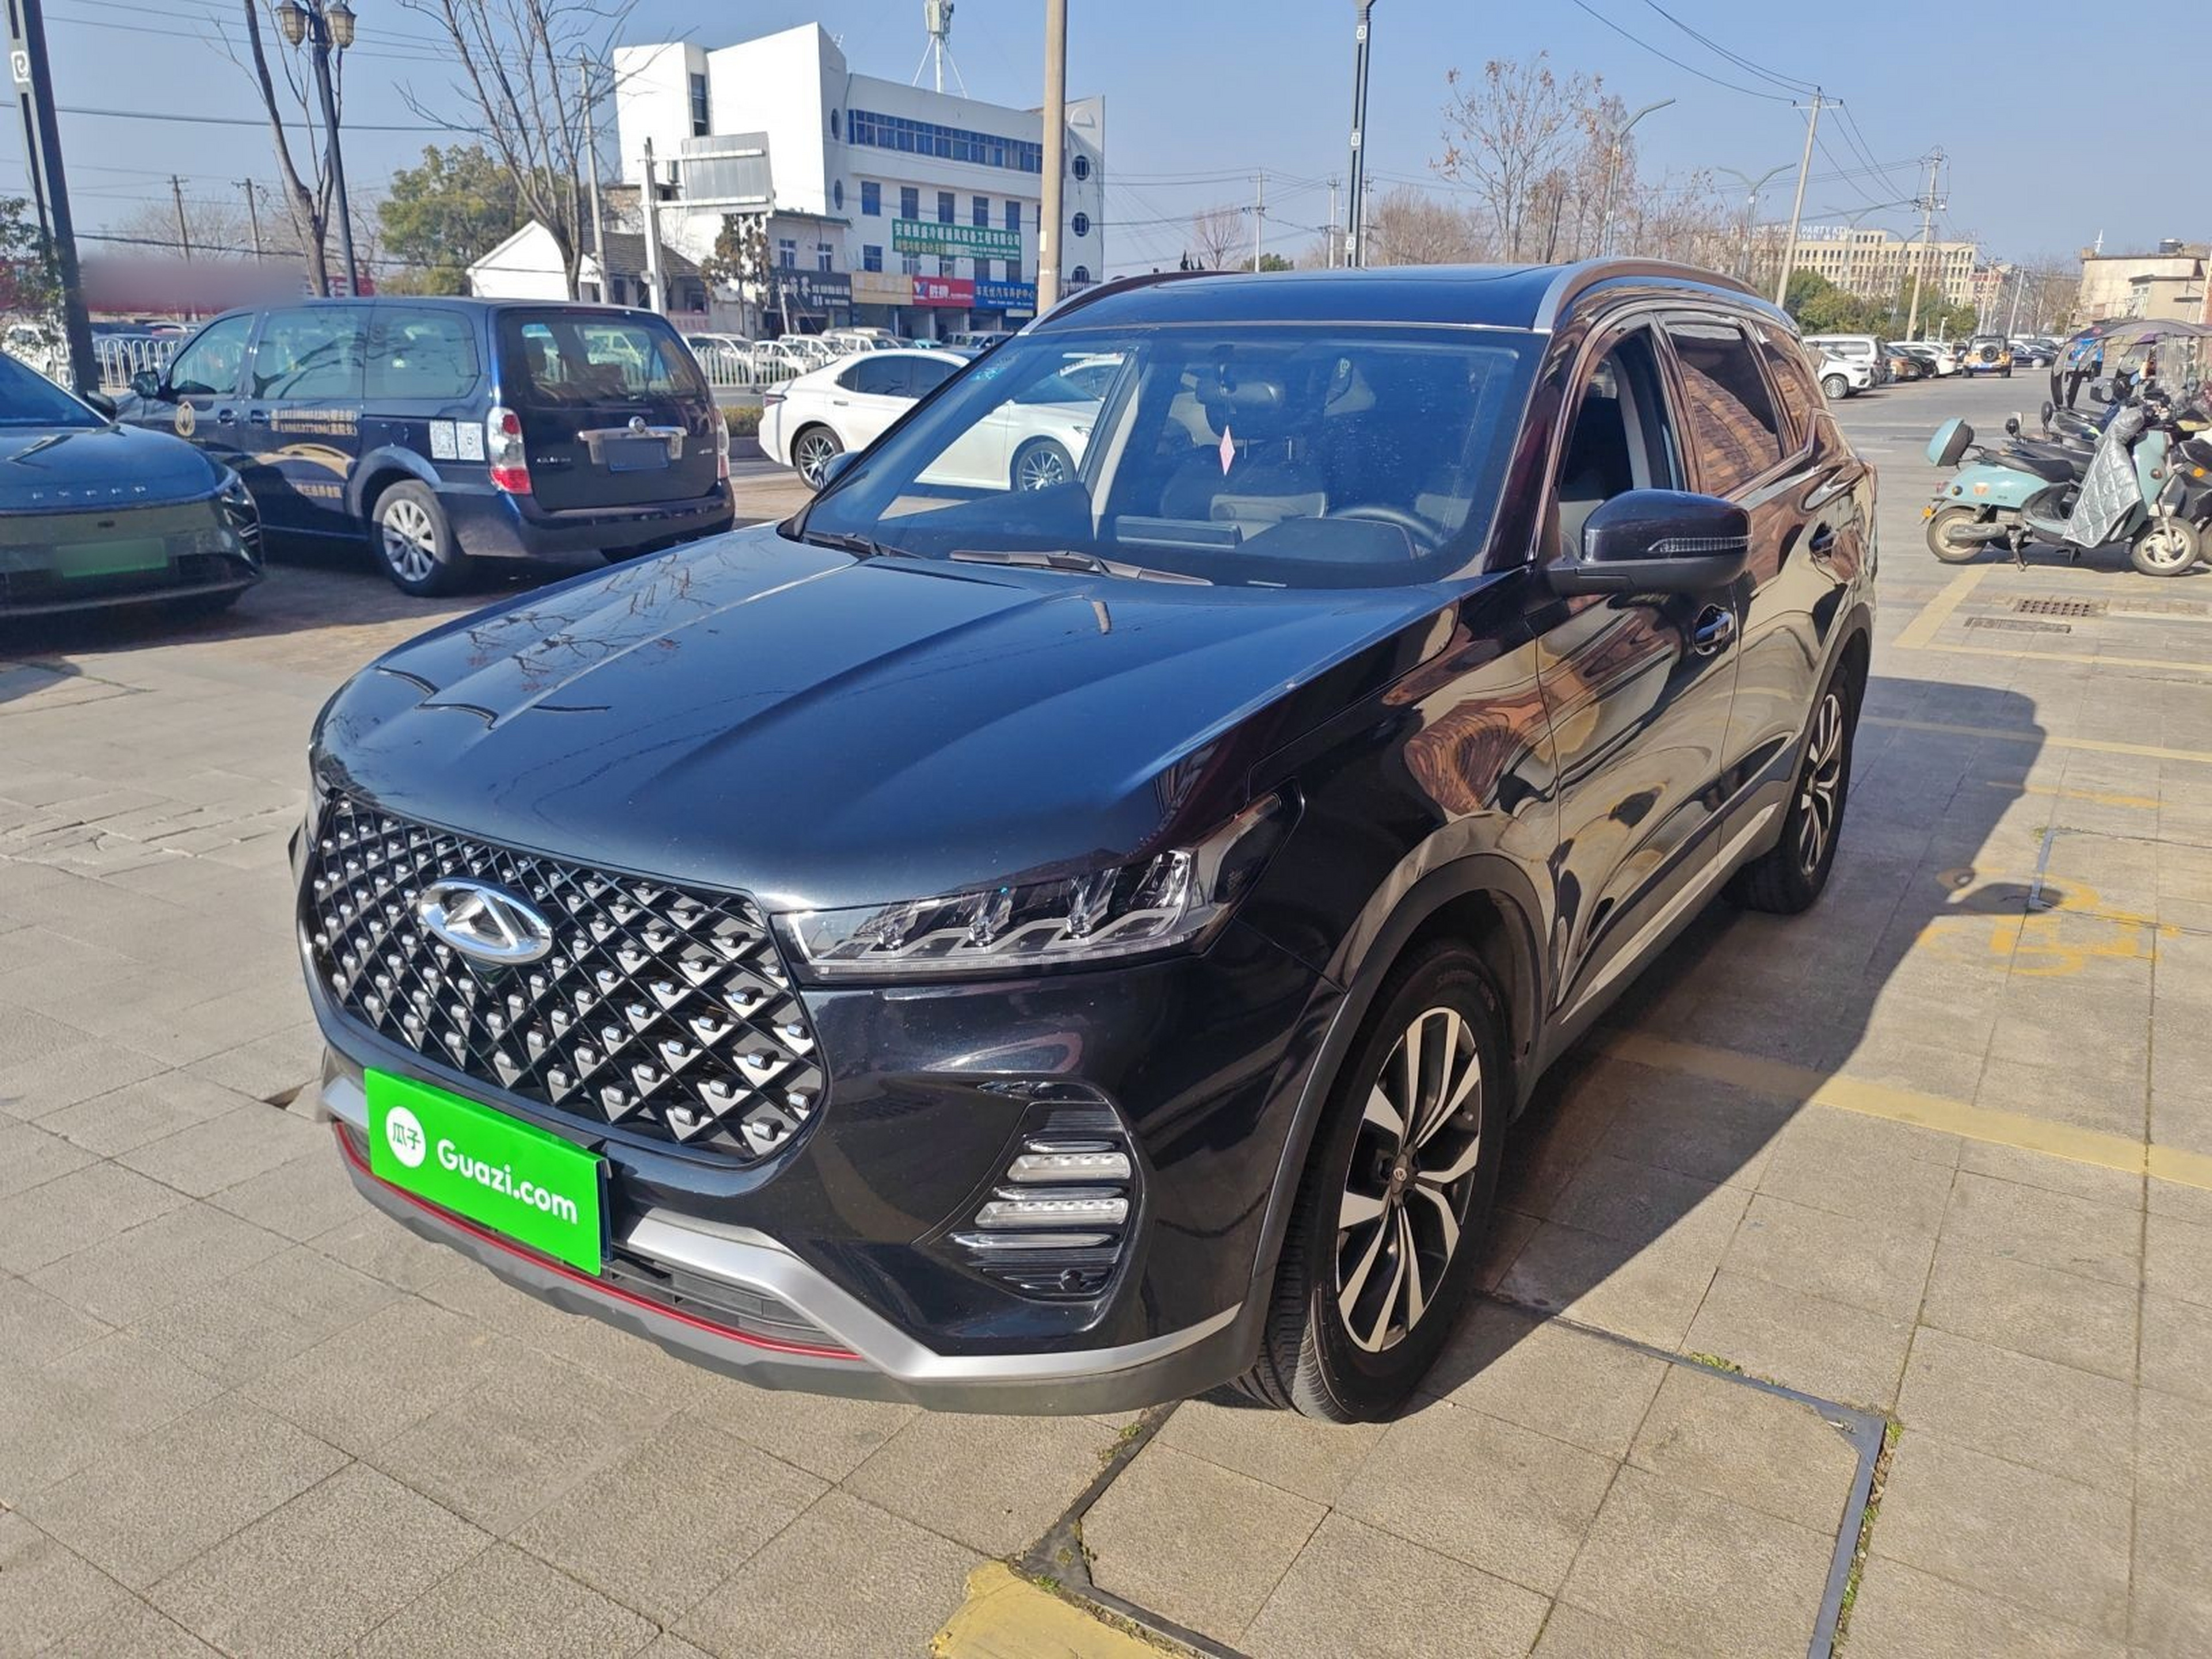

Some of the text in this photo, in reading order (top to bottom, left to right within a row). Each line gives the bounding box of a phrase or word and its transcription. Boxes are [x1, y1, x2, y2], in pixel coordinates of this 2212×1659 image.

[1801, 225, 1830, 234] PARTY
[393, 1122, 421, 1150] 瓜子
[437, 1138, 578, 1225] Guazi.com
